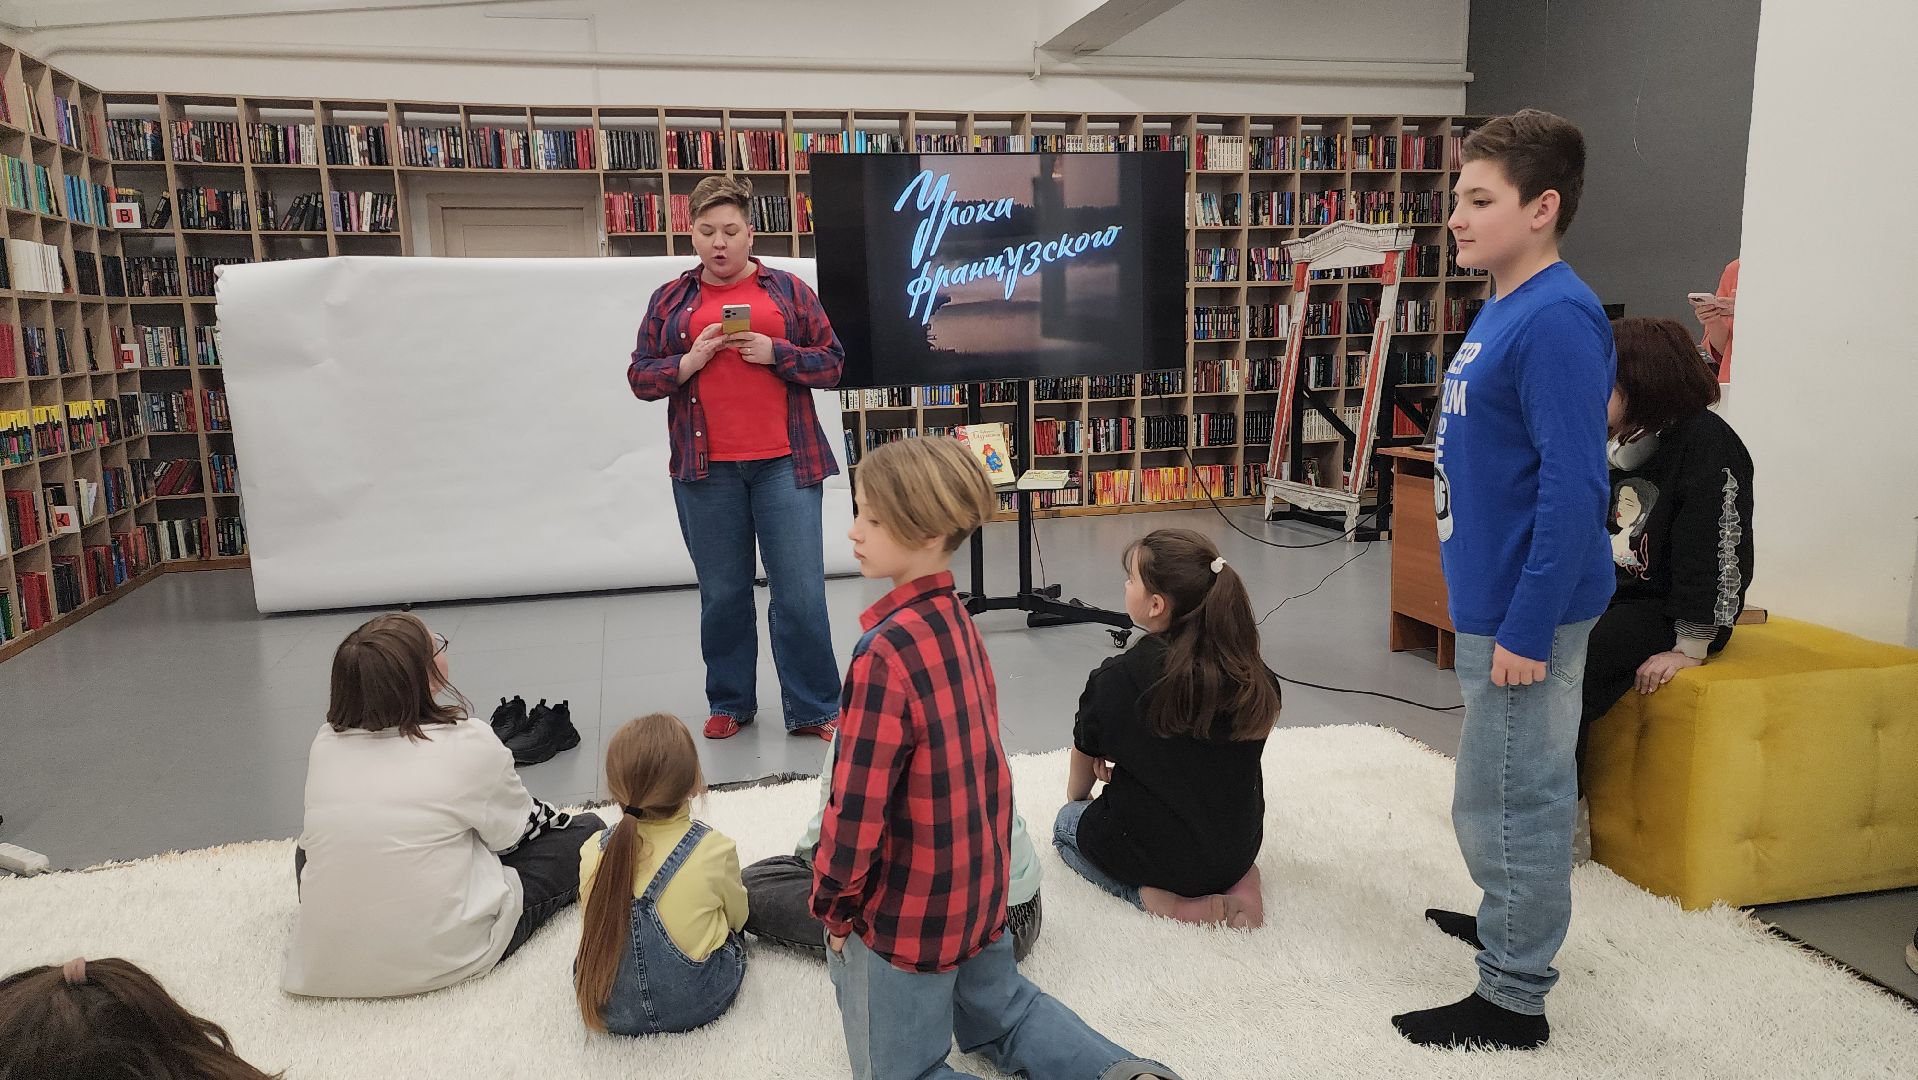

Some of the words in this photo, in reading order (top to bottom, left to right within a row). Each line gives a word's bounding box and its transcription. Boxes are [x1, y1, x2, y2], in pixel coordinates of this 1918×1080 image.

[893, 169, 1015, 269] Уроки
[906, 225, 1123, 326] французского
[1448, 342, 1482, 374] EP
